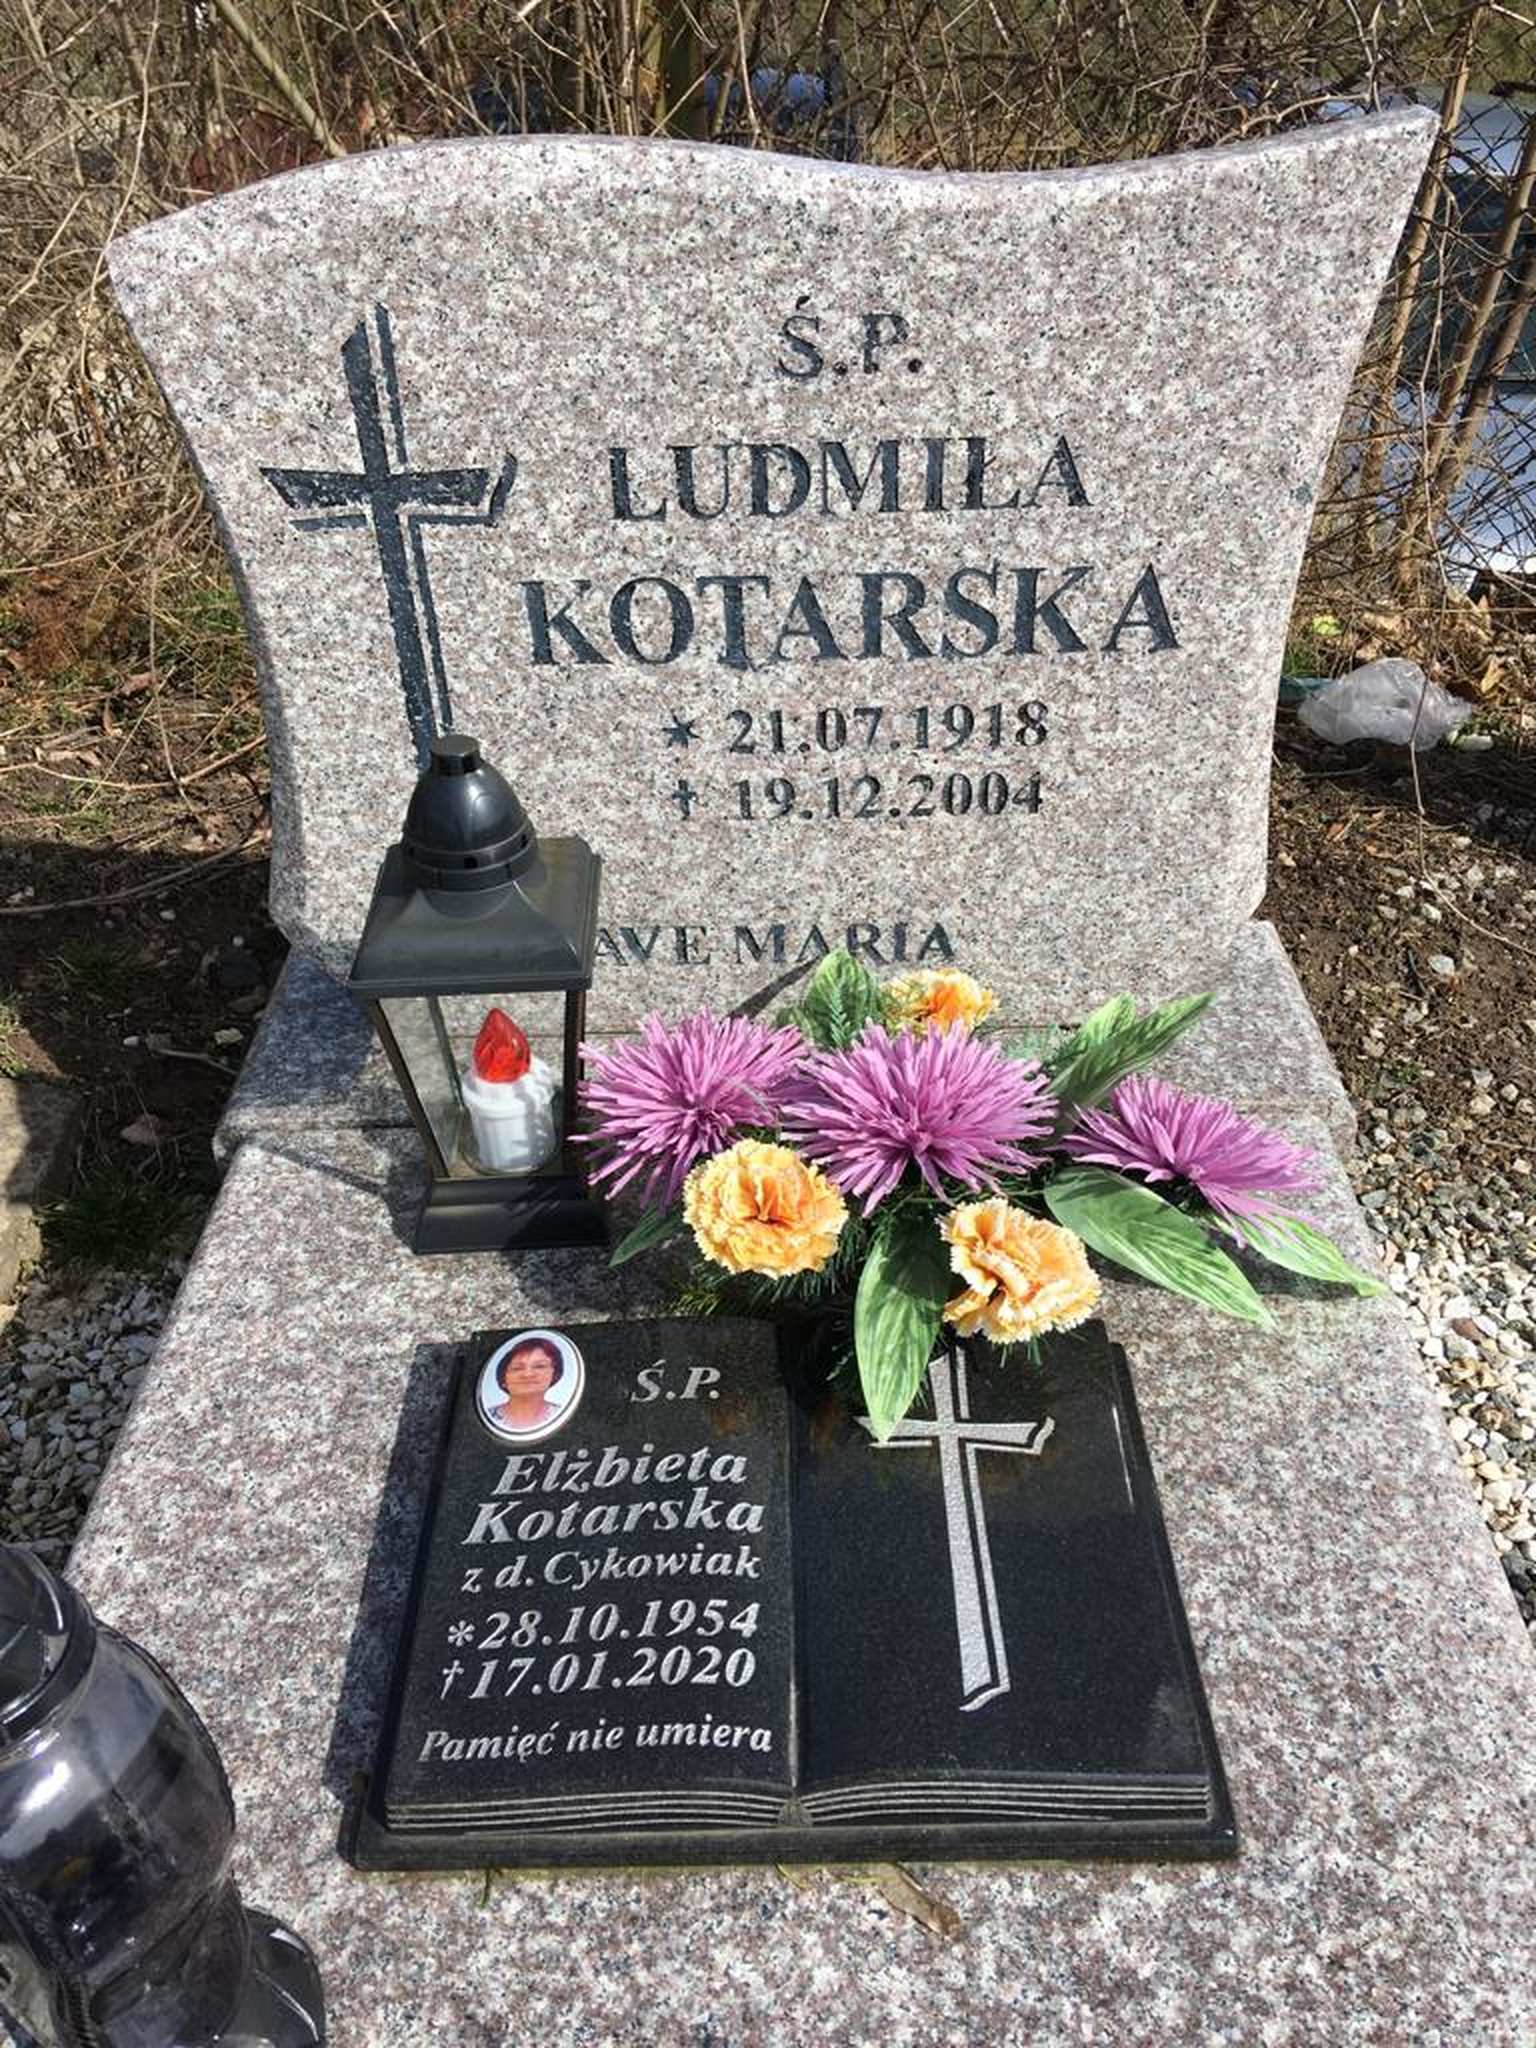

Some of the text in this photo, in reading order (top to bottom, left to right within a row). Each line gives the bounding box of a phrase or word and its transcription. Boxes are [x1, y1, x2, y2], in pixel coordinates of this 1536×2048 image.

[776, 296, 922, 379] Ś.P.
[608, 435, 1093, 521] LUDMIŁA
[520, 562, 1181, 671] KOTARSKA
[725, 700, 1049, 754] 21.07.1918
[730, 772, 1043, 820] 19.12.2004
[594, 921, 956, 966] AVE MARIA
[630, 1359, 721, 1402] Ś.P.
[490, 1443, 749, 1496] Elżbieta
[461, 1487, 766, 1545] Kotarska
[461, 1567, 483, 1593] z
[544, 1543, 761, 1591] Cykowiak
[417, 1714, 773, 1763] Pamięć nie umiera
